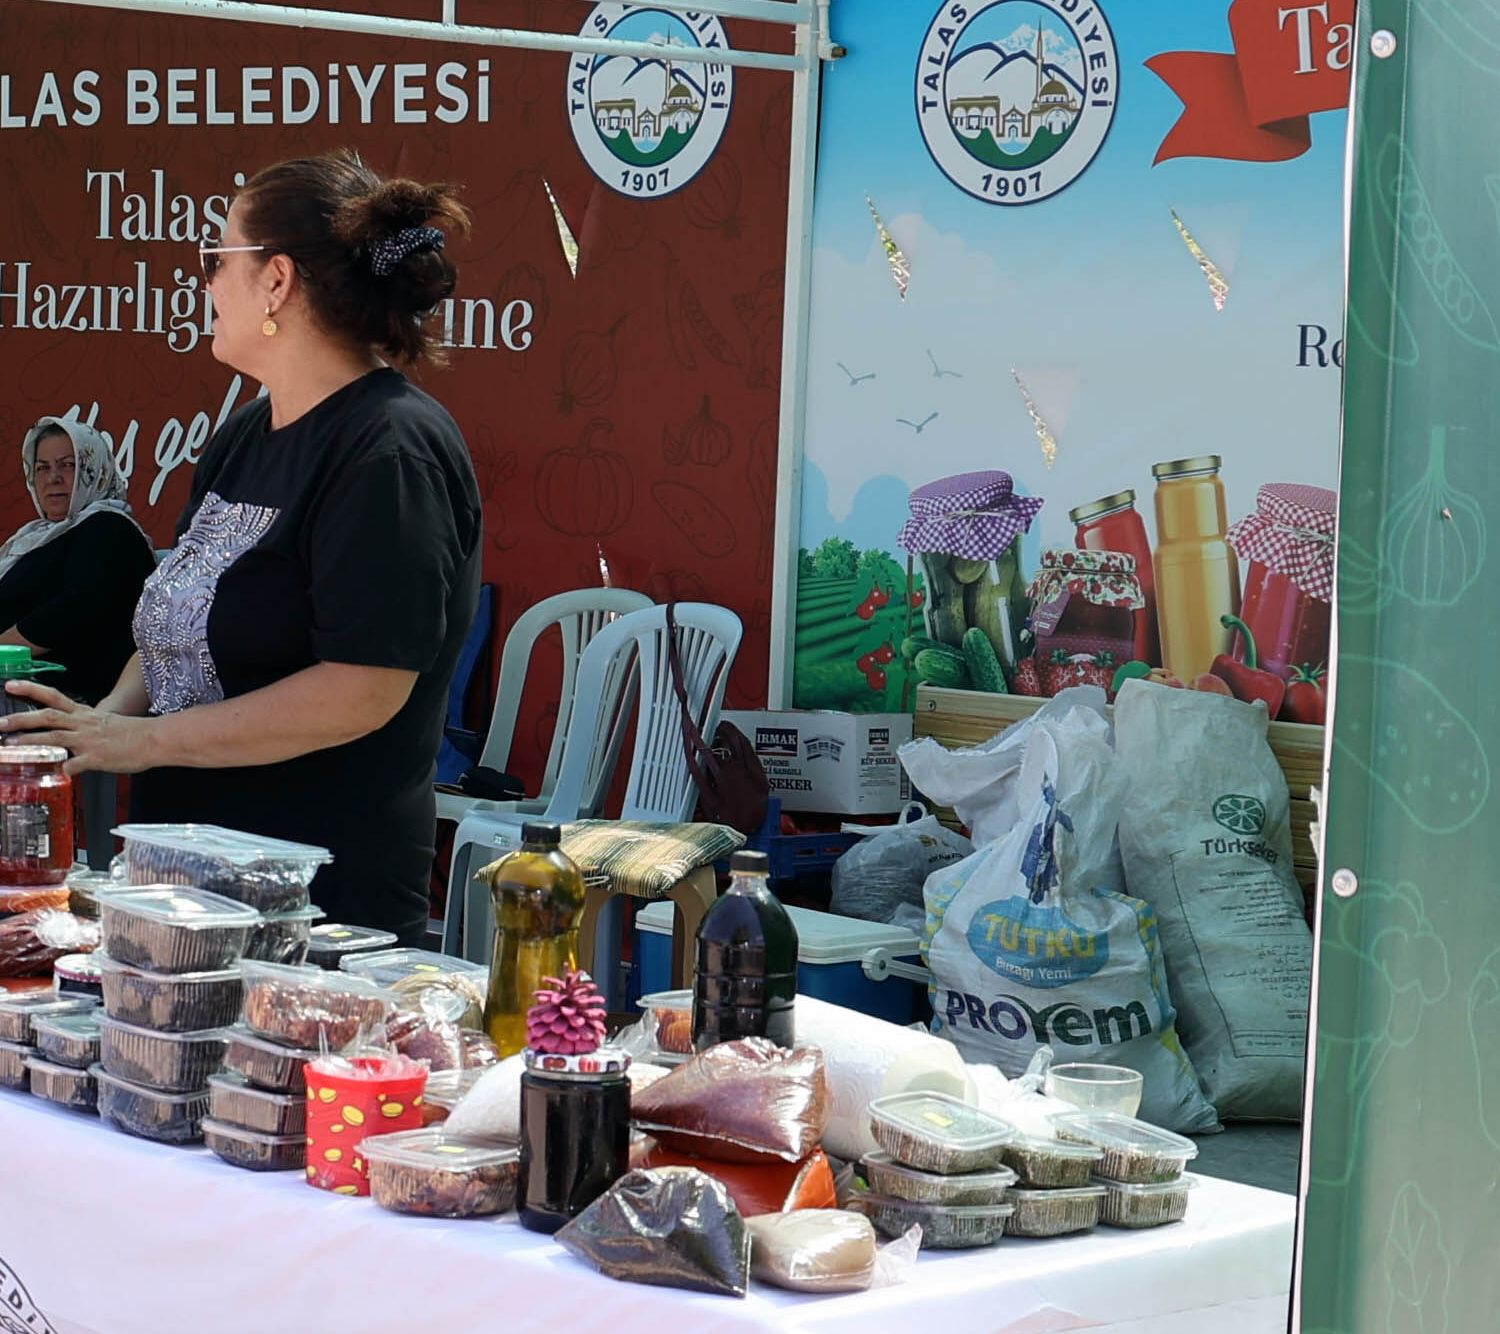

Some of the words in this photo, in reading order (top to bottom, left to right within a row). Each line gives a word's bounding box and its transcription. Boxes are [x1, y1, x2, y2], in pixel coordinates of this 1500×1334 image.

[571, 13, 609, 116] TALS
[921, 2, 969, 113] TALAS
[126, 57, 492, 126] BELEDİYESİ
[620, 166, 671, 192] 1907
[981, 169, 1045, 199] 1907
[756, 733, 798, 745] IRMAK
[983, 913, 1097, 958] TUTKU
[1038, 967, 1073, 980] Yemi
